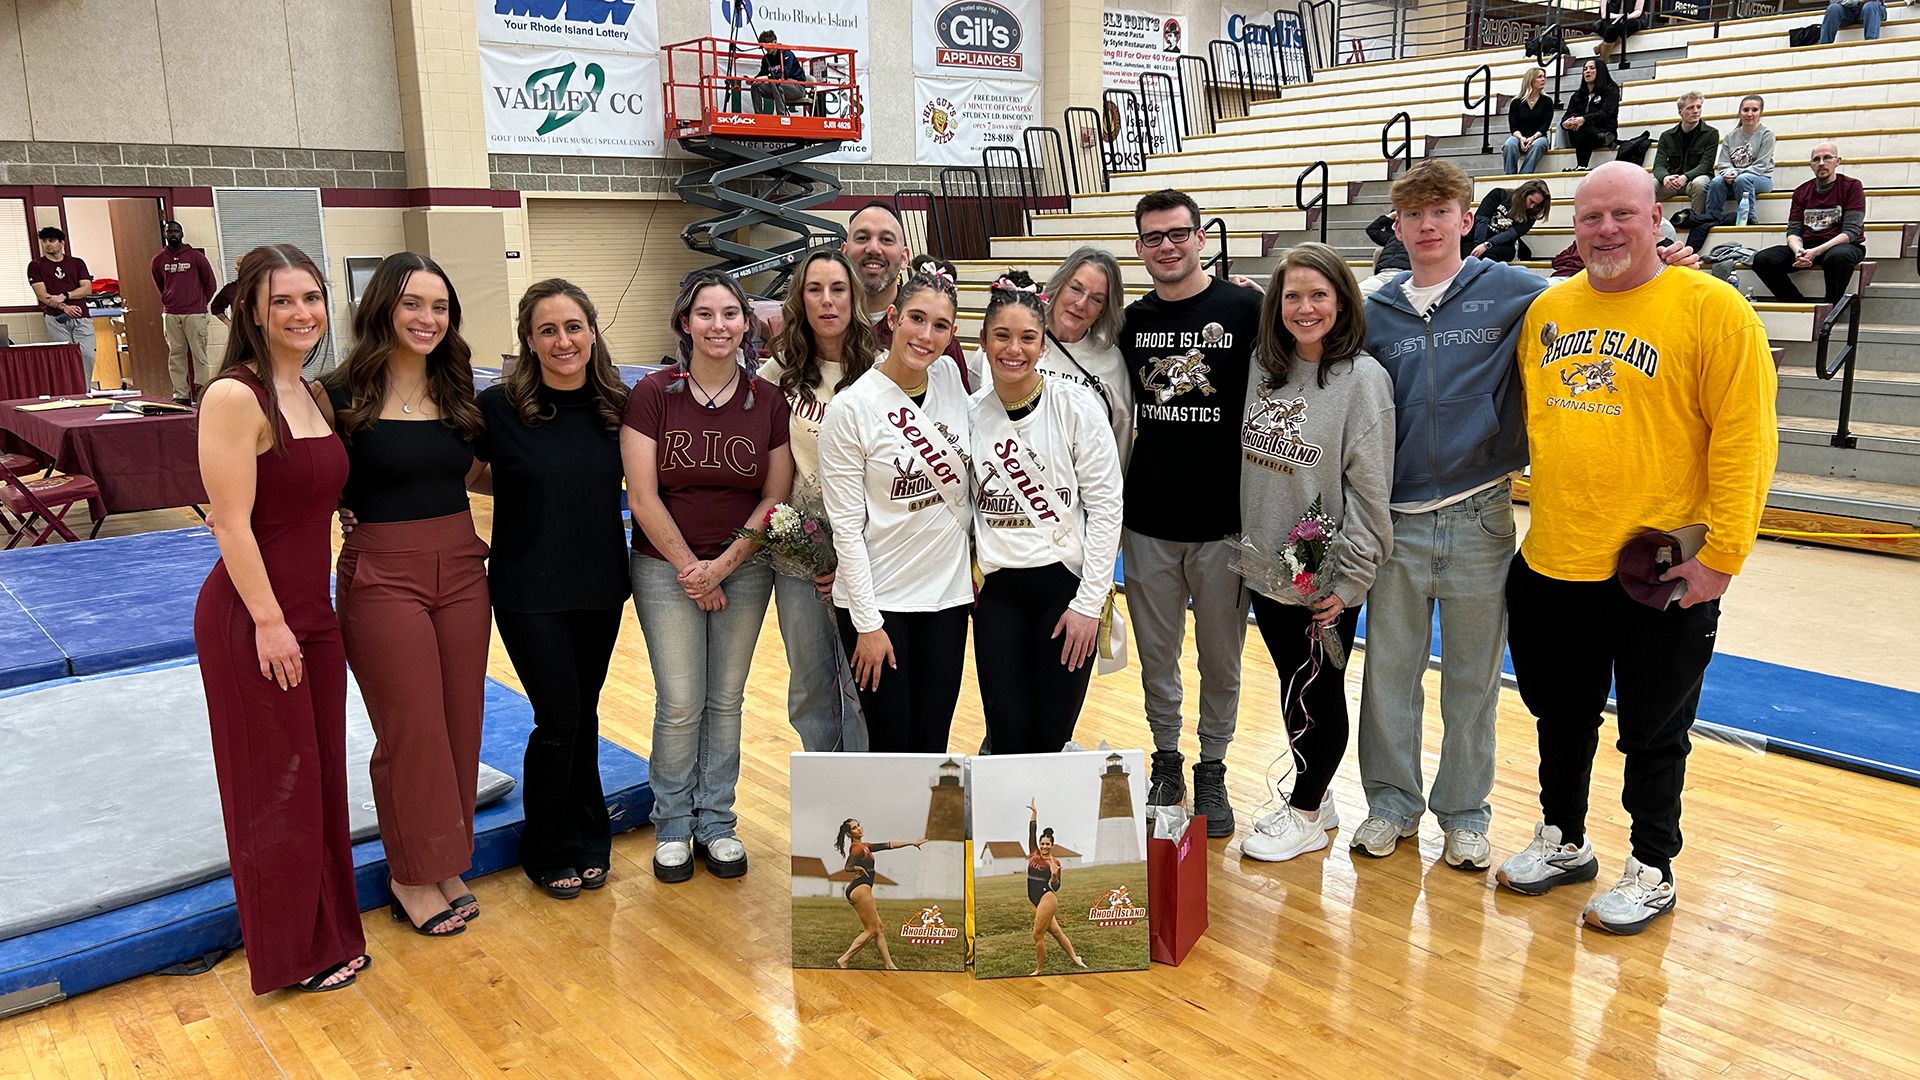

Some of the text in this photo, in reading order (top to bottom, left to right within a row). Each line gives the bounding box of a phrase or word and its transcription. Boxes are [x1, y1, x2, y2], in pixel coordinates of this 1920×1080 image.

[758, 5, 858, 29] Ortho Rhode Island
[1124, 14, 1160, 32] TONY'S
[504, 20, 629, 41] Your Rhode Island Lottery
[950, 15, 1010, 49] Gil's
[1129, 31, 1144, 39] Pasta
[1110, 38, 1123, 48] Style
[1124, 41, 1157, 50] Restaurants
[942, 52, 1017, 67] APPLIANCES
[1124, 51, 1135, 59] For
[1152, 53, 1160, 61] 40
[493, 86, 643, 115] VALLEY CC
[991, 95, 1023, 103] DELIVERY!
[1006, 104, 1033, 112] CAMPUS!
[923, 97, 957, 124] THIS GUY'S
[717, 115, 756, 125] SKYJACK
[570, 137, 594, 145] MUSIC
[599, 138, 628, 146] SPECIAL
[629, 139, 656, 147] EVENTS
[933, 130, 955, 144] PIZZA
[838, 144, 867, 153] ervice
[1462, 300, 1495, 312] GT
[1135, 332, 1175, 348] RHODE
[1540, 329, 1659, 379] RHODE ISLAND
[1142, 403, 1221, 422] GYMNASTICS
[1546, 396, 1622, 416] GYMNASTICS
[660, 430, 758, 477] RIC
[887, 407, 961, 485] Senior
[1271, 435, 1318, 463] ISLAND
[1246, 453, 1294, 475] GYMNASTICS
[894, 477, 936, 497] RHOD
[994, 438, 1060, 522] Senior
[1091, 907, 1145, 918] RHODE ISLAND
[902, 925, 957, 936] RHODE ISLAND
